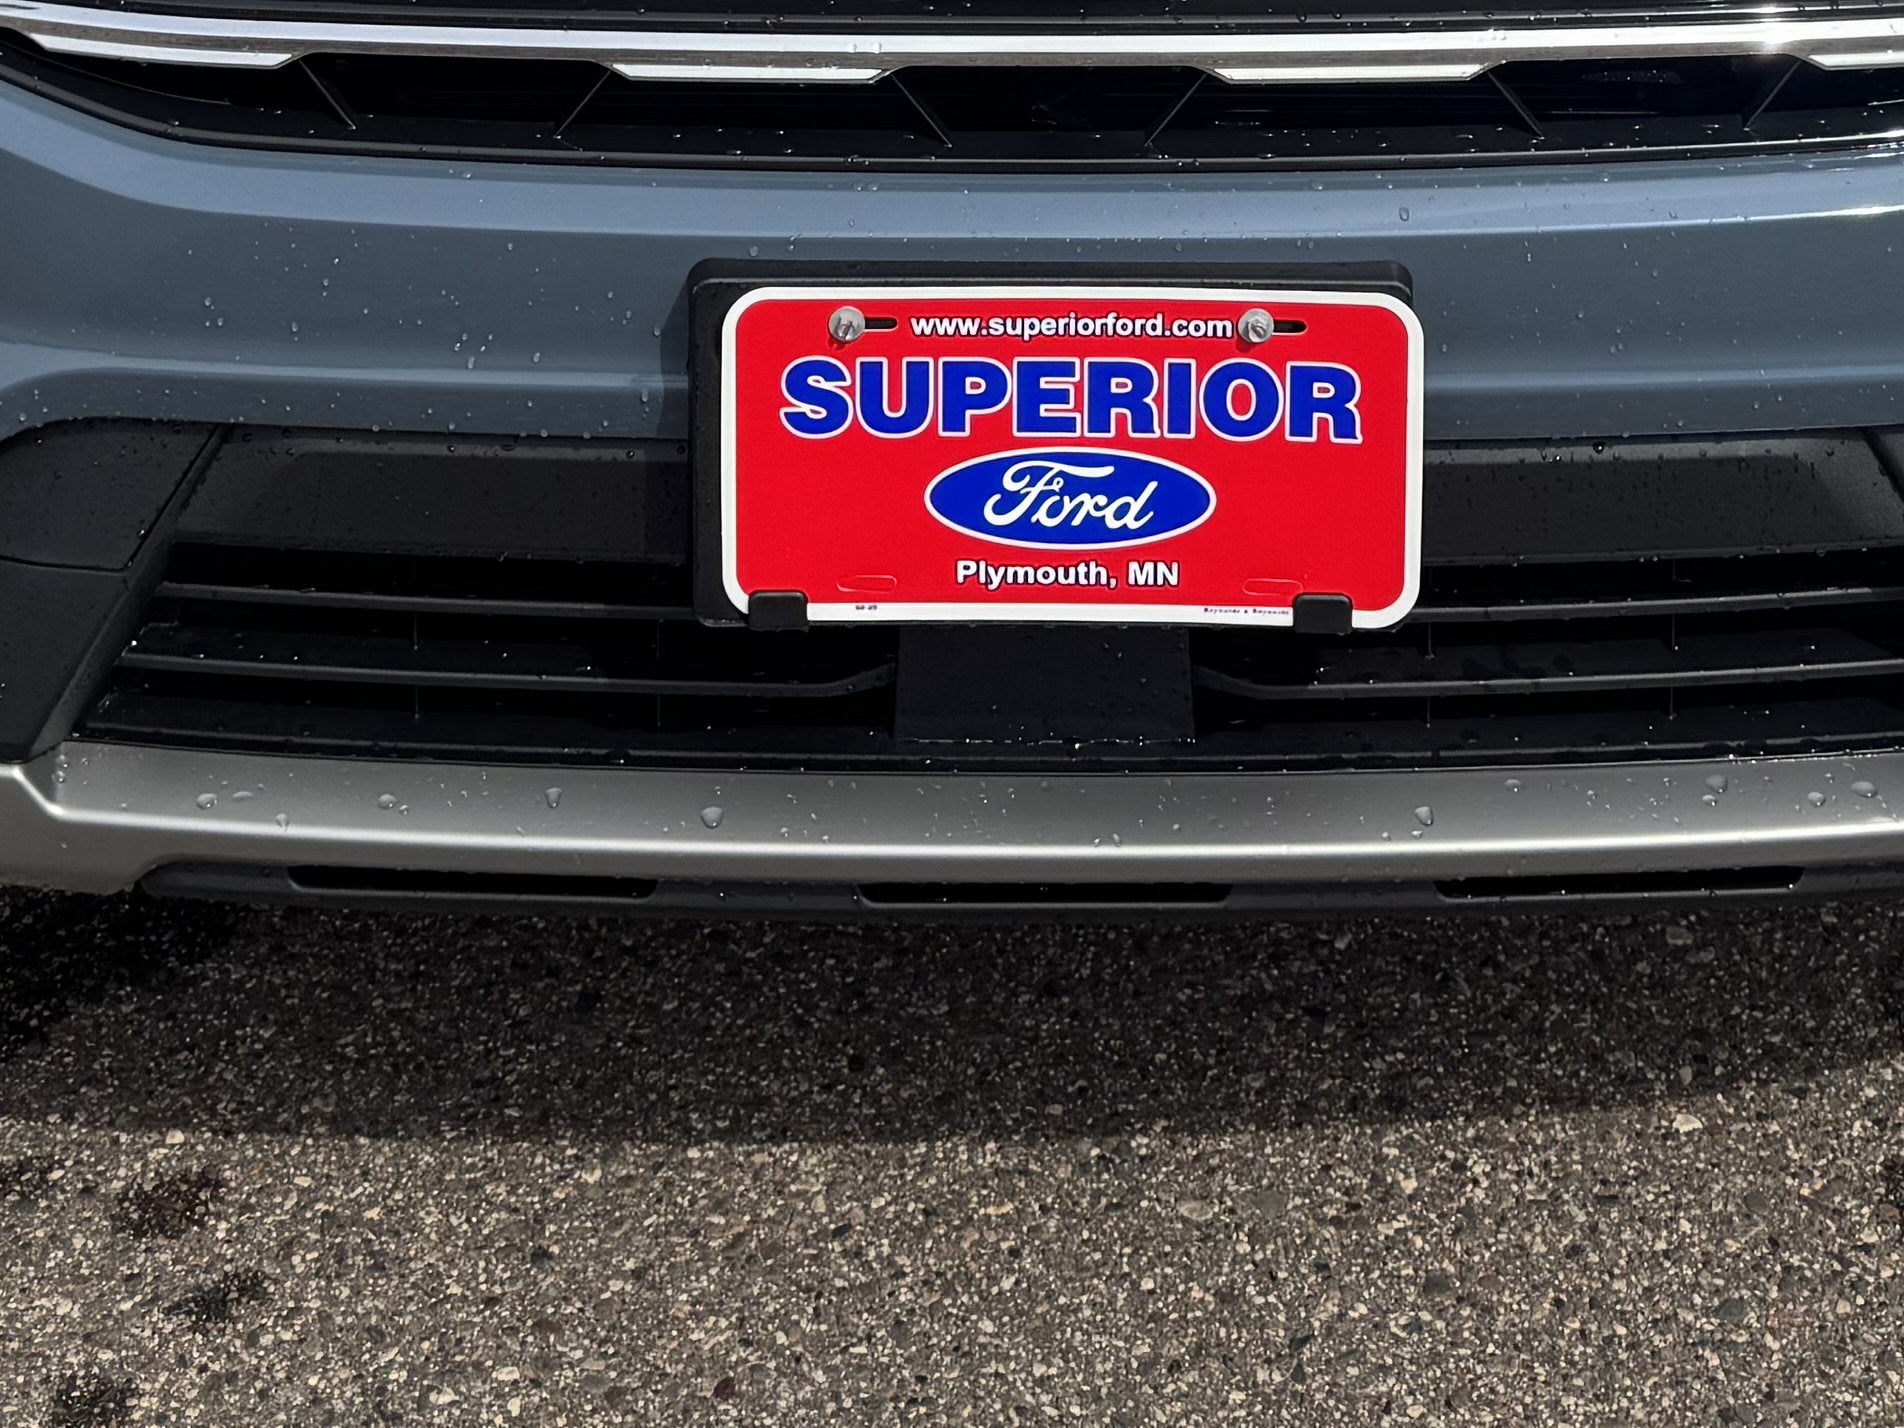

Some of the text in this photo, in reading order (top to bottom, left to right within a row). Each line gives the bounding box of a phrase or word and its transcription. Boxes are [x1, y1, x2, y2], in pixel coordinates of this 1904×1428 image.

[909, 312, 1234, 341] www.superiorford.com
[779, 355, 1363, 444] SUPERIOR
[983, 459, 1158, 530] Ford
[956, 559, 1180, 590] Plymouth, MN
